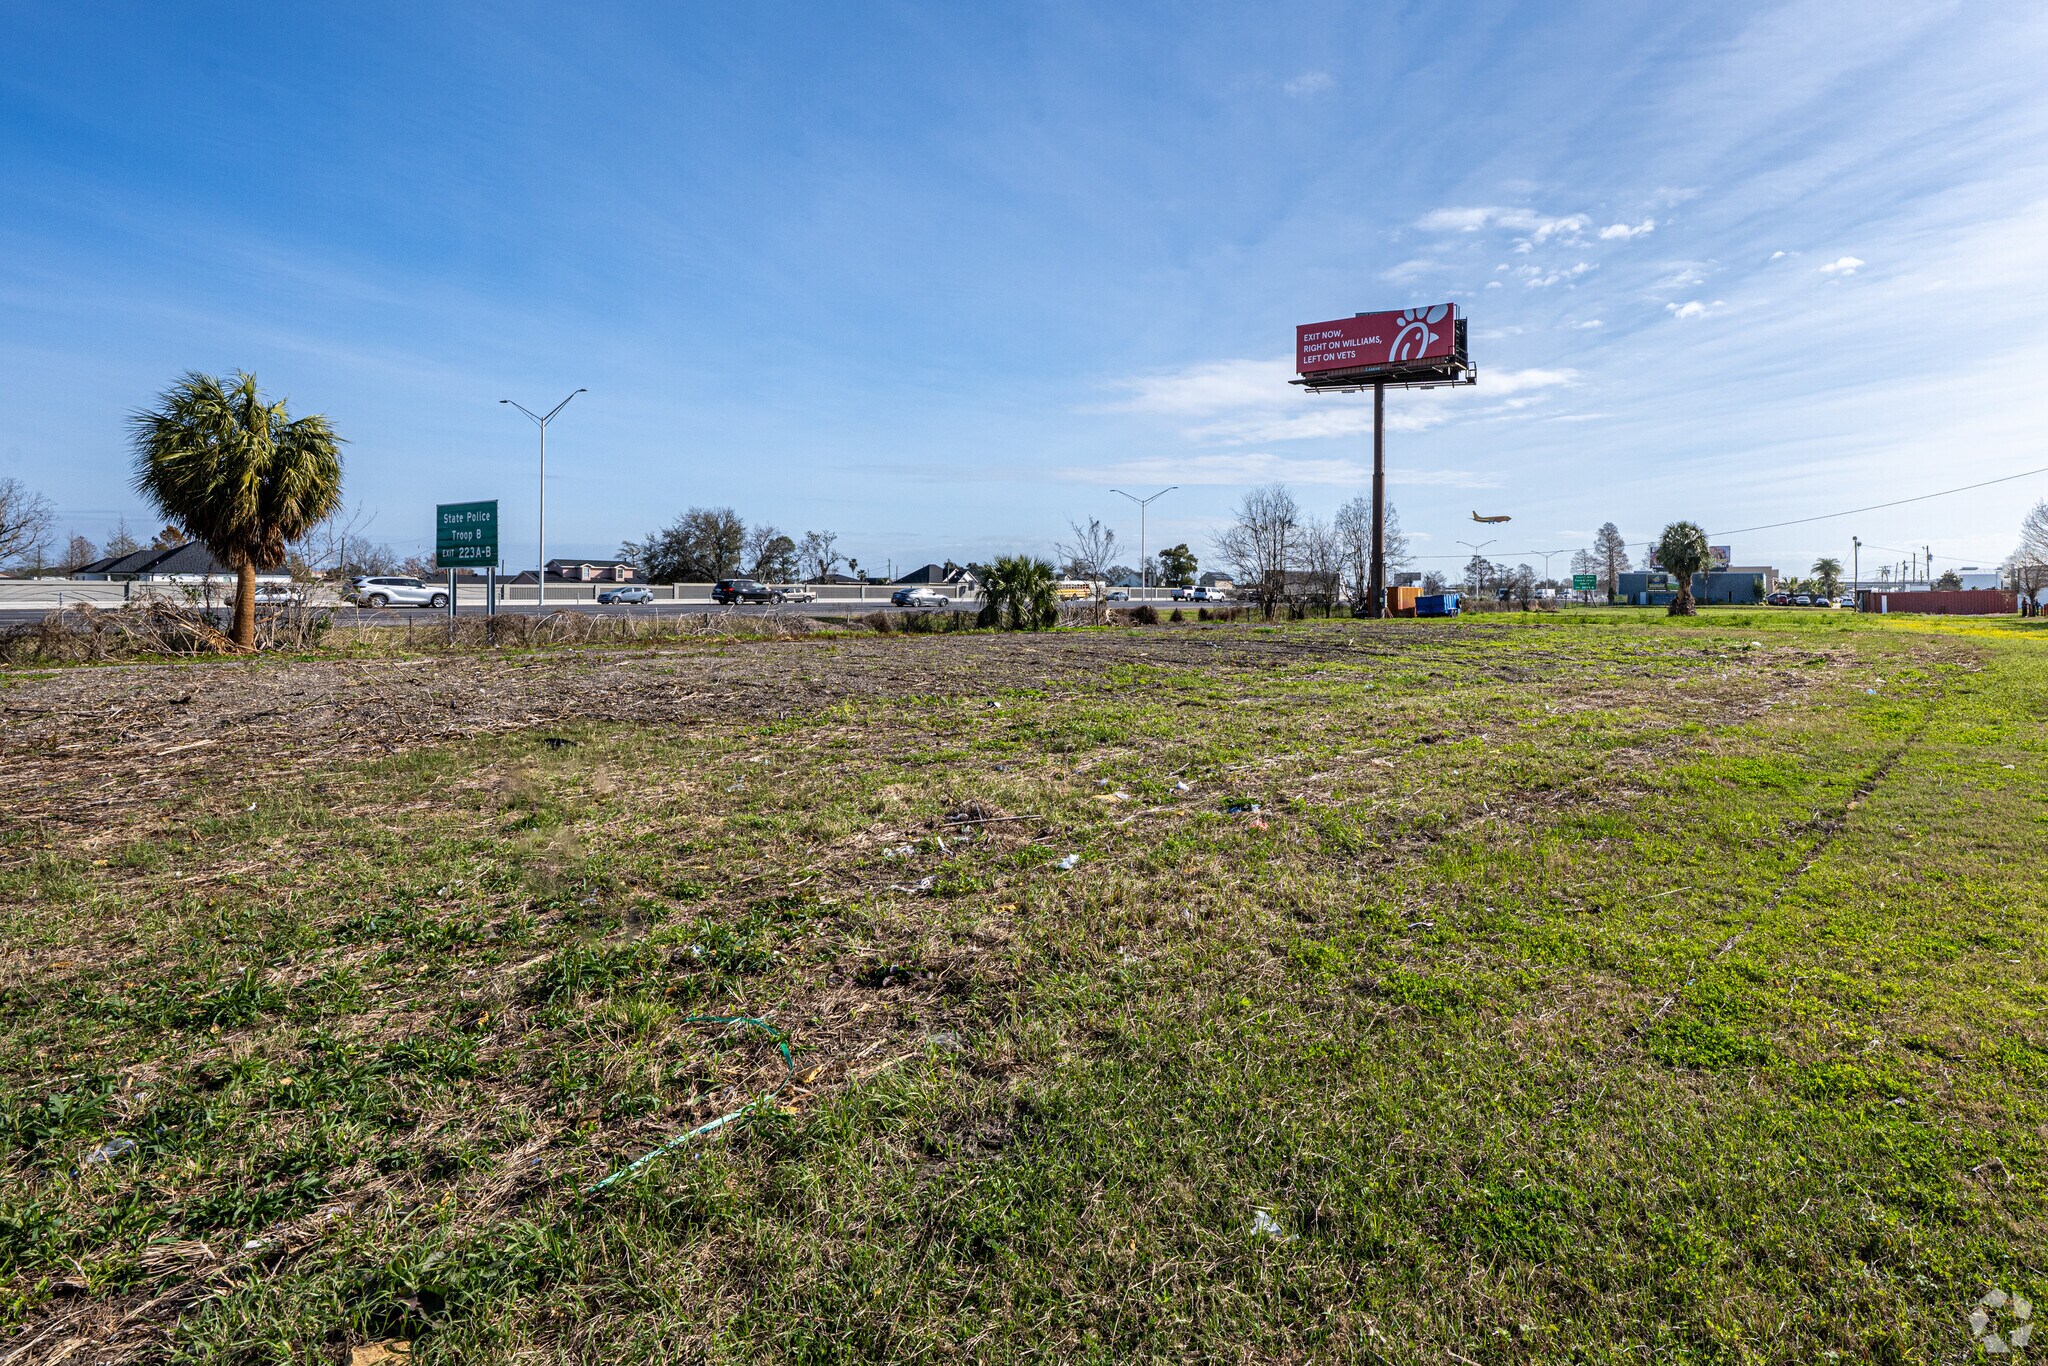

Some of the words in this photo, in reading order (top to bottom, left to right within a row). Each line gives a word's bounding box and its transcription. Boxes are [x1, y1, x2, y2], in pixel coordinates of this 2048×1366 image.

[1303, 332, 1320, 342] EXIT
[1321, 329, 1344, 340] NOW,
[1303, 342, 1327, 353] RIGHT
[1328, 341, 1340, 350] ON
[1342, 335, 1382, 348] WILLIAMS,
[1303, 354, 1321, 364] LEFT
[1322, 353, 1335, 362] ON
[1336, 350, 1356, 360] VETS
[443, 513, 464, 524] State
[466, 511, 491, 522] Police
[451, 530, 473, 542] Troop
[476, 528, 482, 540] B
[442, 549, 455, 558] EXIT
[458, 546, 491, 558] 223A-B
